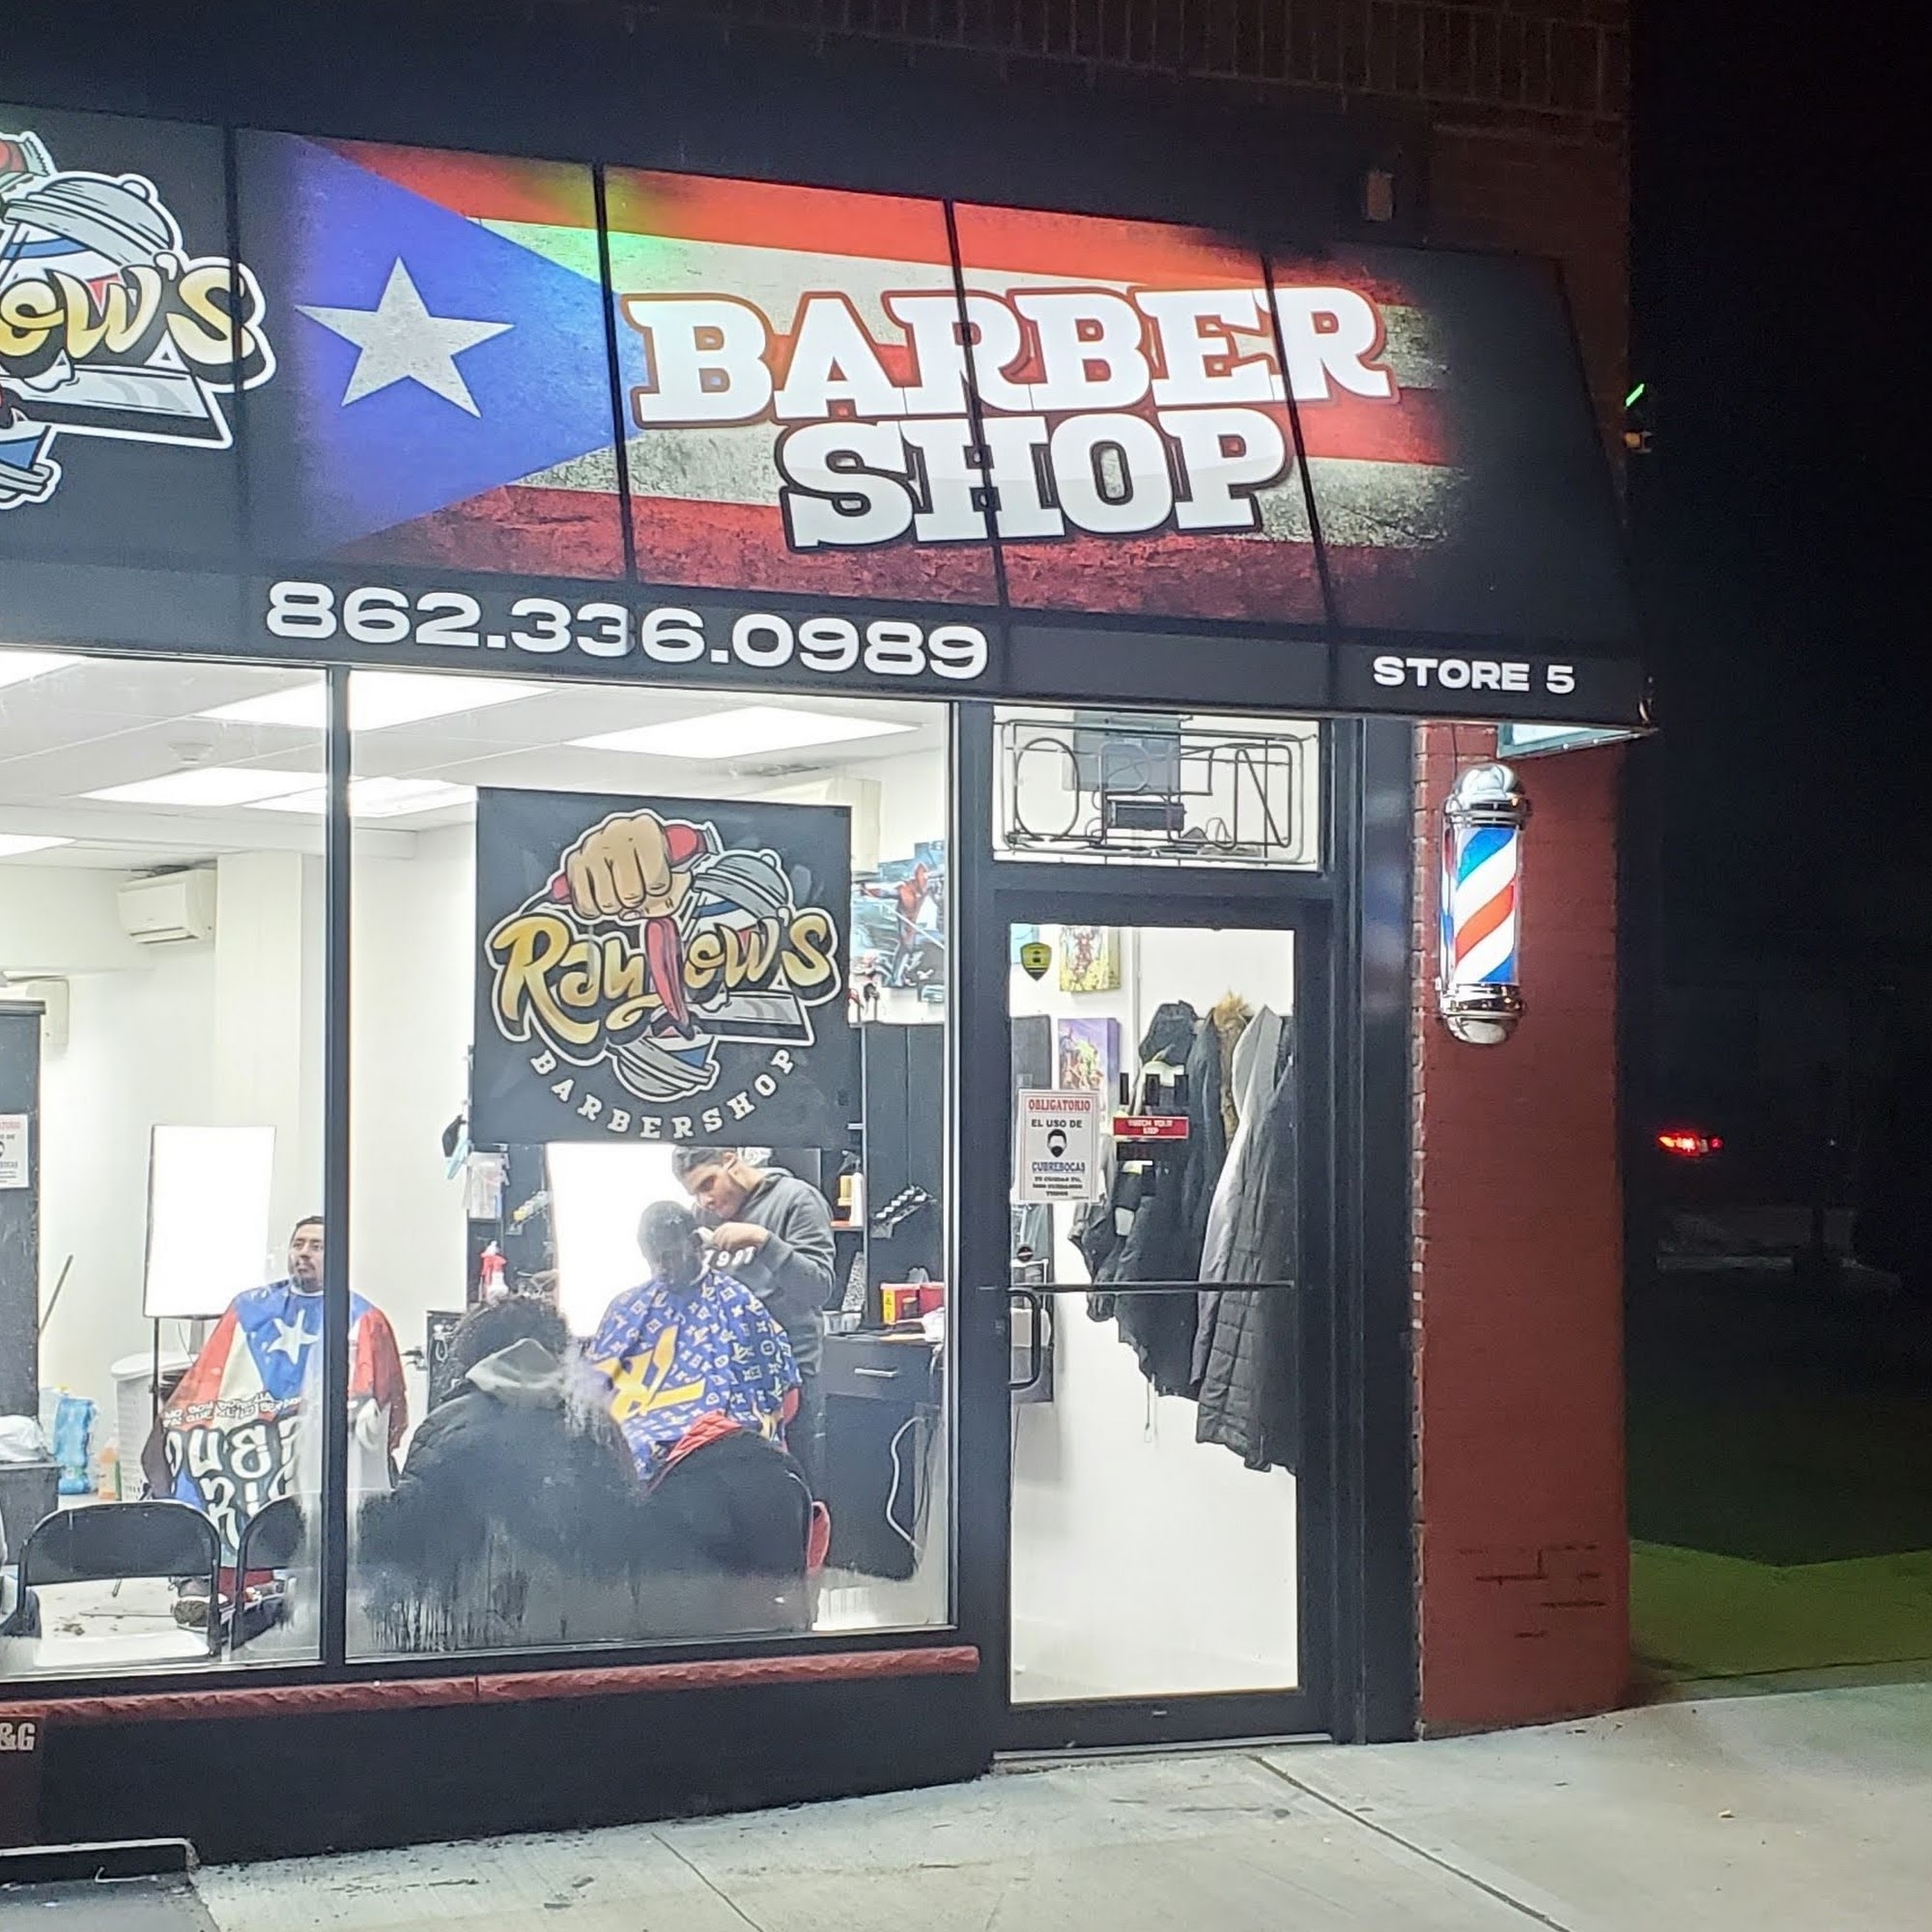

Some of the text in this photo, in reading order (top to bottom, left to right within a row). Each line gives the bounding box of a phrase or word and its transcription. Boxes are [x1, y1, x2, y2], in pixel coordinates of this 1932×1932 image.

[624, 287, 1395, 426] BARBER
[779, 409, 1288, 550] SHOP
[266, 581, 988, 680] 862.336.0989
[1373, 655, 1576, 694] STORE 5
[530, 1048, 795, 1139] BARBERSHOP
[1028, 1099, 1091, 1112] OBLIGATORIO
[1031, 1119, 1082, 1128] EL USO DE
[1032, 1161, 1086, 1173] CUBREBOCAS
